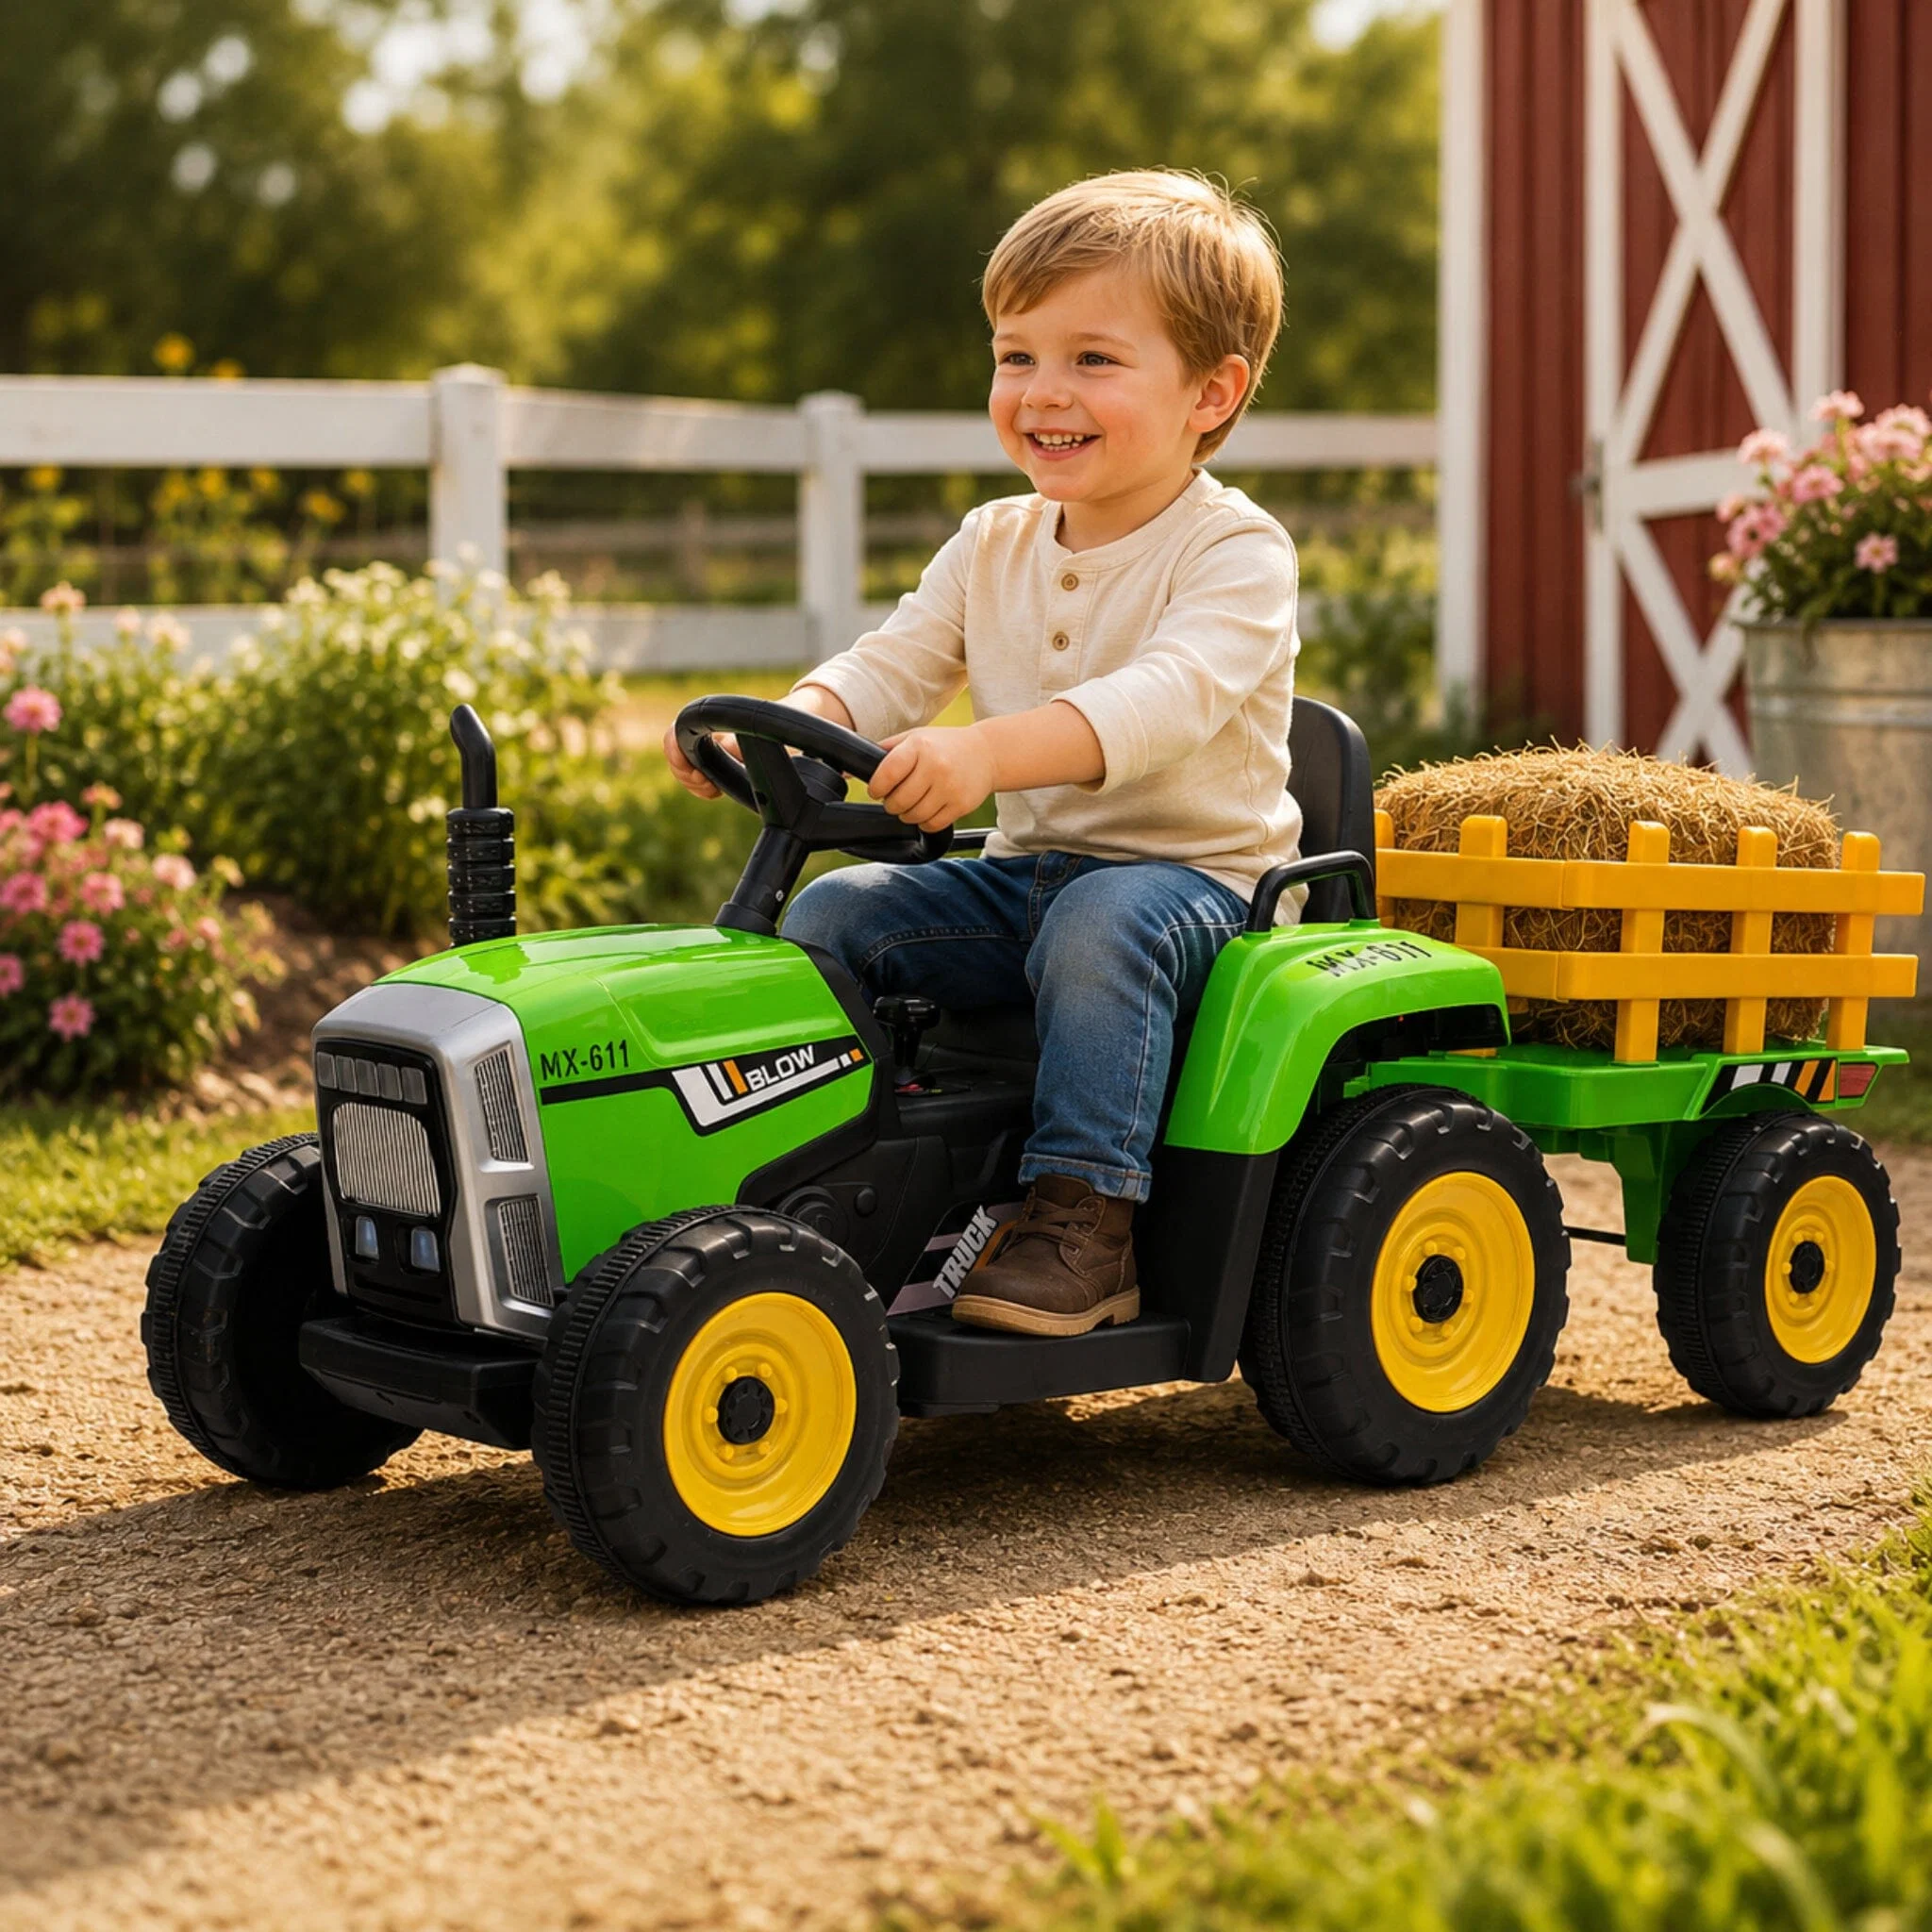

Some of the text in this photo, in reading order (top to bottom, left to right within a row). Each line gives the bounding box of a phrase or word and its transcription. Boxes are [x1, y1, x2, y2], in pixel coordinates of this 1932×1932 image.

[541, 1040, 629, 1080] MX-611
[745, 1044, 816, 1091] BLOW
[932, 1205, 998, 1298] TRUCK
